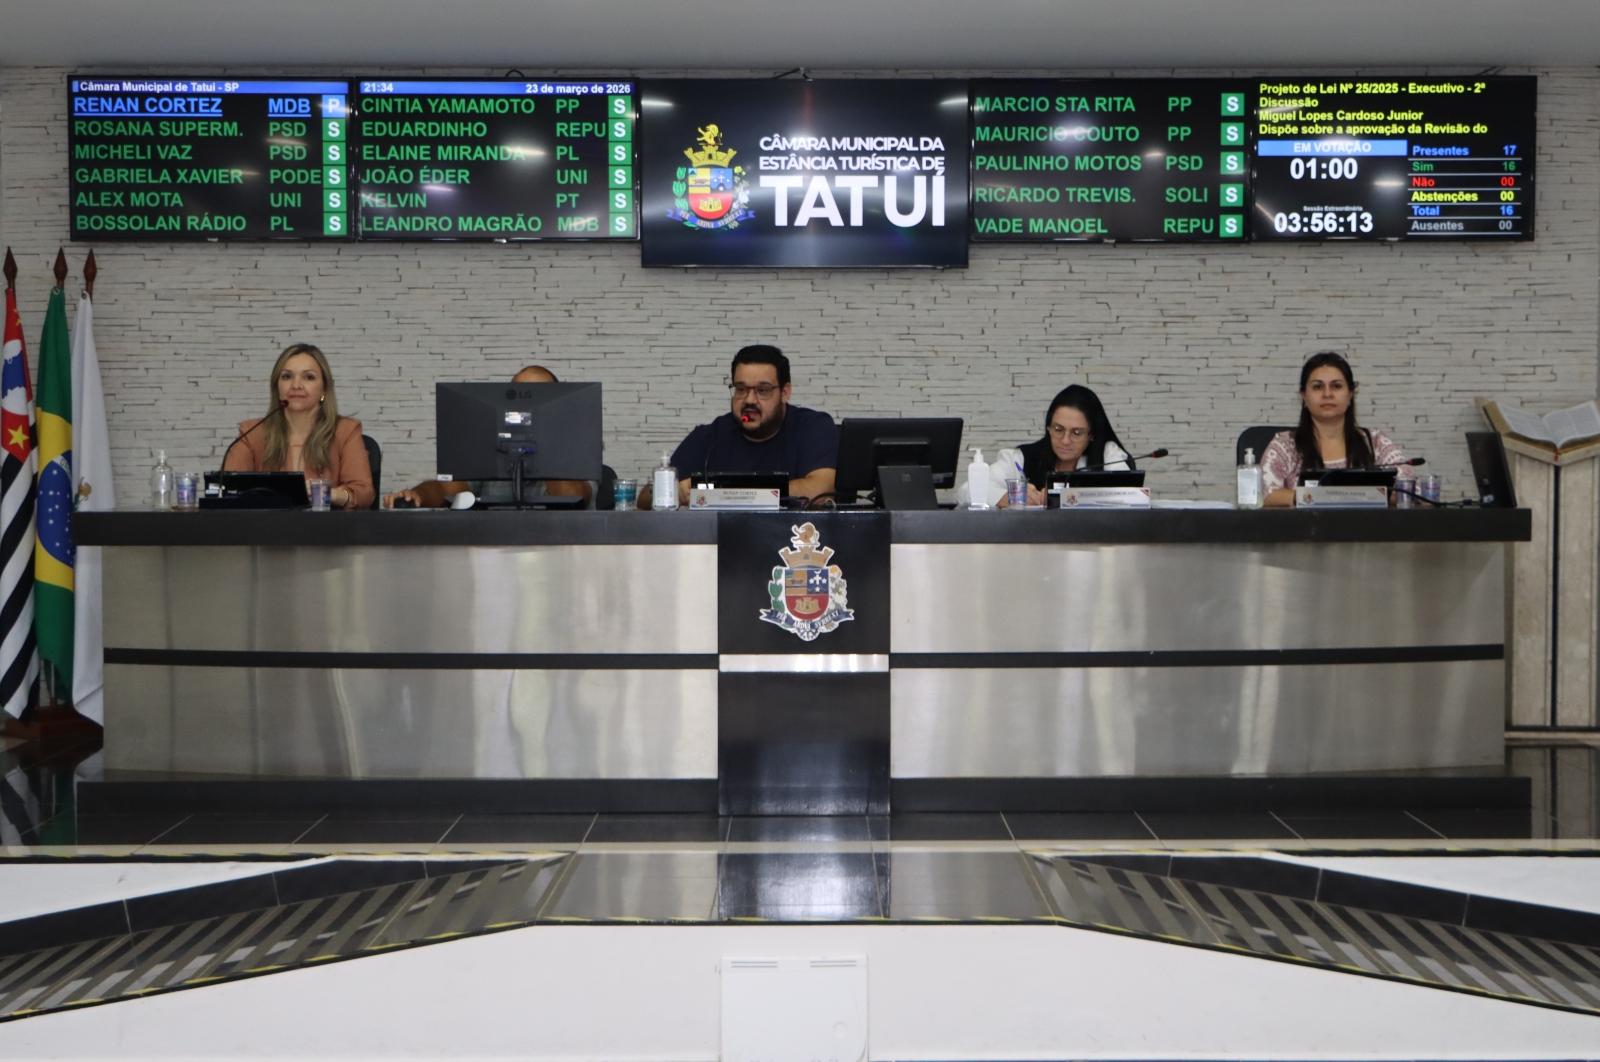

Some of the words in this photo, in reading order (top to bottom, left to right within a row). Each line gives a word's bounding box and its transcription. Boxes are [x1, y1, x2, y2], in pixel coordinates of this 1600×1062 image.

[80, 82, 120, 92] Câmara
[123, 82, 172, 93] Municipal
[175, 82, 188, 92] de
[225, 83, 239, 92] SP
[365, 83, 393, 93] 21:34
[526, 84, 538, 93] 23
[541, 84, 553, 93] de
[556, 85, 588, 95] março
[591, 85, 604, 93] de
[606, 85, 631, 93] 2026
[1260, 84, 1300, 96] Projeto
[1303, 84, 1317, 93] de
[1320, 83, 1337, 93] Lei
[1356, 83, 1398, 93] 25/2025
[1408, 83, 1464, 93] Executivo
[74, 97, 139, 112] RENAN
[145, 97, 222, 113] CORTEZ
[268, 98, 311, 113] MDB
[328, 98, 340, 114] P
[362, 99, 423, 114] CINTIA
[427, 99, 535, 114] YAMAMOTO
[556, 99, 579, 114] PP
[613, 99, 626, 114] S
[976, 97, 1050, 112] MARCIO
[1055, 97, 1089, 112] STA
[1095, 97, 1135, 112] RITA
[1168, 97, 1192, 112] PP
[1227, 97, 1239, 112] S
[1260, 97, 1318, 107] Discussão
[1259, 111, 1296, 123] Miguel
[1299, 111, 1333, 123] Lopes
[1336, 110, 1384, 120] Cardoso
[1387, 110, 1423, 120] Junior
[75, 121, 154, 136] ROSANA
[159, 121, 243, 136] SUPERM.
[269, 122, 306, 137] PSD
[328, 122, 340, 137] S
[362, 122, 487, 137] EDUARDINHO
[556, 122, 606, 137] REPU
[614, 122, 626, 137] S
[975, 126, 1067, 141] MAURICIO
[1073, 126, 1140, 141] COUTO
[1168, 127, 1192, 141] PP
[1226, 126, 1239, 141] S
[1259, 124, 1298, 136] Dispõe
[1301, 124, 1333, 134] sobre
[1336, 126, 1343, 134] a
[1346, 124, 1405, 137] aprovação
[1408, 124, 1421, 134] da
[1424, 123, 1470, 134] Revisão
[1473, 123, 1488, 134] do
[759, 133, 831, 151] CÂMARA
[832, 137, 918, 151] MUNICIPAL
[920, 137, 945, 151] DA
[1294, 143, 1311, 152] EM
[1314, 140, 1372, 154] VOTAÇÃO
[75, 145, 151, 160] MICHELI
[157, 145, 193, 160] VAZ
[269, 145, 307, 160] PSD
[328, 146, 340, 161] S
[362, 145, 431, 160] ELAINE
[438, 146, 526, 161] MIRANDA
[556, 146, 579, 160] PL
[614, 146, 626, 161] S
[1413, 145, 1469, 156] Presentes
[1504, 145, 1517, 155] 17
[759, 153, 838, 170] ESTÂNCIA
[838, 153, 920, 170] TURÍSTICA
[922, 157, 945, 170] DE
[975, 155, 1069, 170] PAULINHO
[1075, 155, 1141, 171] MOTOS
[1166, 156, 1203, 171] PSD
[1226, 156, 1238, 171] S
[1290, 158, 1358, 179] 01:00
[1413, 162, 1433, 171] Sim
[1503, 162, 1515, 171] 16
[75, 168, 172, 183] GABRIELA
[177, 169, 243, 183] XAVIER
[270, 169, 322, 184] PODE
[328, 169, 341, 184] S
[362, 166, 413, 184] JOÃO
[420, 166, 470, 184] ÉDER
[556, 170, 588, 184] UNI
[614, 169, 627, 184] S
[1413, 177, 1435, 187] Não
[1501, 177, 1514, 186] 00
[75, 192, 124, 207] ALEX
[130, 192, 184, 207] MOTA
[270, 193, 301, 207] UNI
[329, 193, 341, 208] S
[362, 193, 427, 208] KELVIN
[556, 193, 579, 208] PT
[615, 193, 627, 208] S
[760, 170, 945, 227] TATUÍ
[975, 187, 1060, 203] RICARDO
[1066, 188, 1136, 203] TREVIS.
[1165, 188, 1208, 202] SOLI
[1226, 188, 1238, 203] S
[1412, 191, 1478, 203] Abstenções
[1500, 191, 1514, 201] 00
[1412, 205, 1440, 215] Total
[1500, 205, 1514, 215] 16
[77, 216, 181, 231] BOSSOLAN
[187, 212, 247, 231] RÁDIO
[271, 217, 293, 231] PL
[329, 216, 341, 231] S
[362, 217, 452, 232] LEANDRO
[458, 213, 542, 232] MAGRÃO
[558, 217, 599, 231] MDB
[615, 216, 627, 231] S
[975, 218, 1023, 233] VADE
[1029, 218, 1108, 233] MANOEL
[1164, 219, 1214, 234] REPU
[1225, 218, 1237, 234] S
[1274, 212, 1373, 233] 03:56:13
[1411, 221, 1464, 230] Ausentes
[1499, 220, 1512, 230] 00
